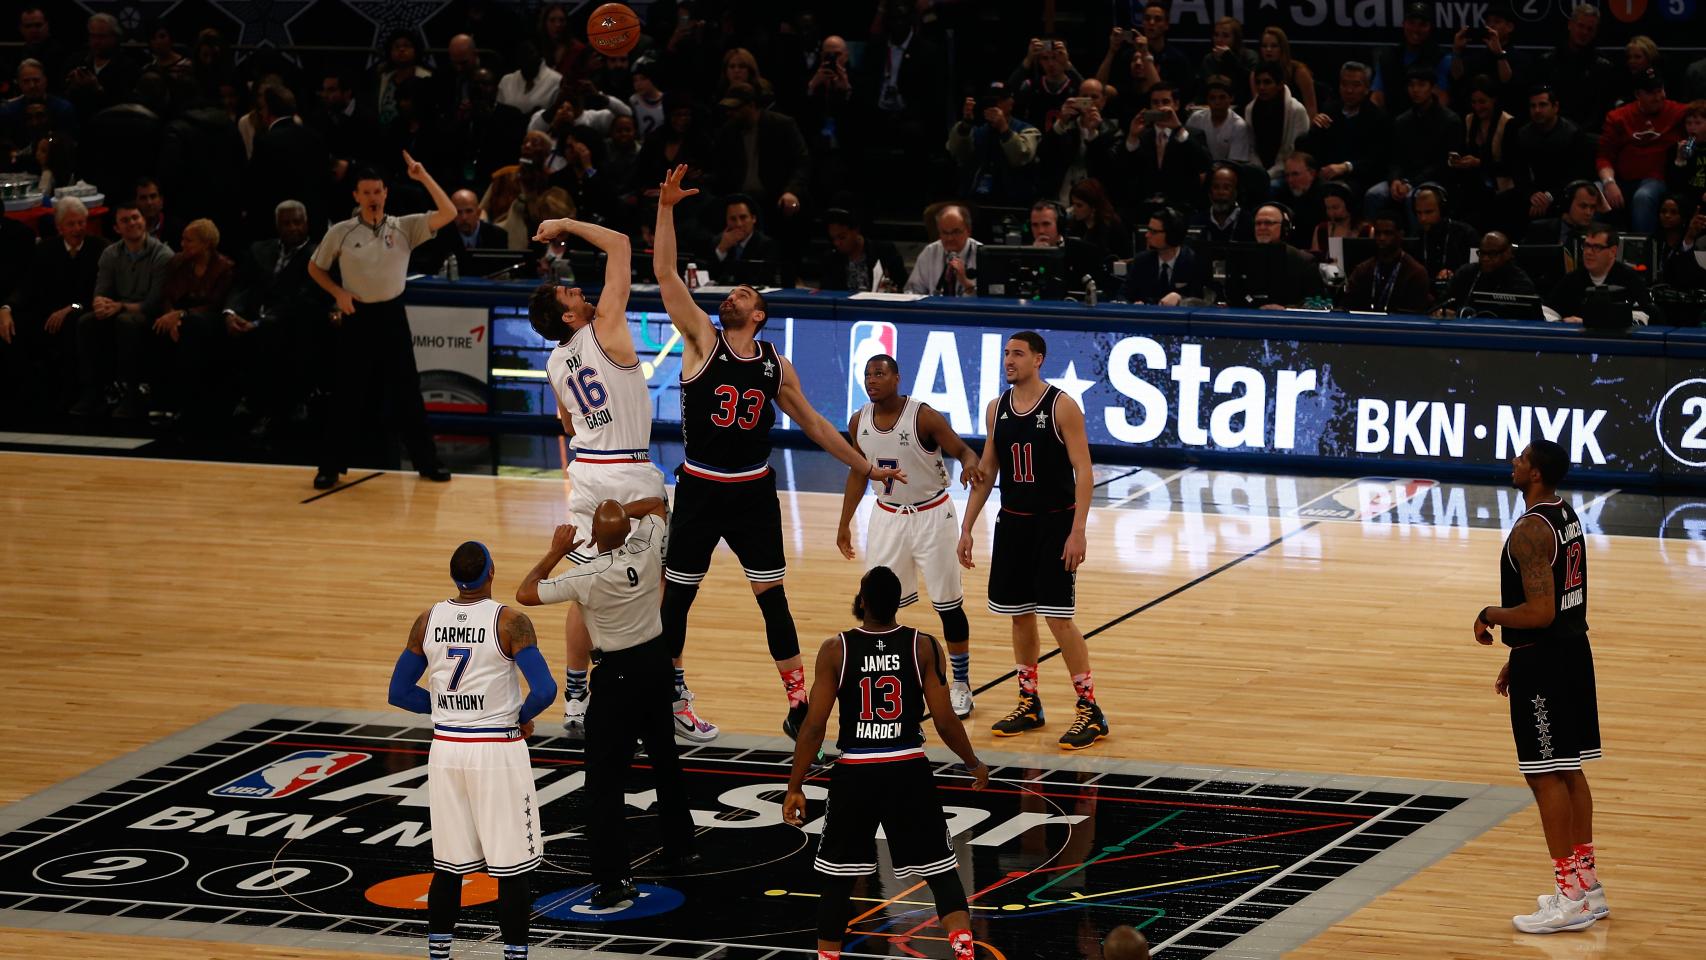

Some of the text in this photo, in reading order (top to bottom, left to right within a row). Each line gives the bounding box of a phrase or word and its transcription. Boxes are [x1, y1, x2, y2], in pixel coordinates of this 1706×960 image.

[1290, 0, 1404, 28] Sta
[411, 335, 473, 350] UMHO TIRE
[566, 365, 609, 416] 16
[1104, 335, 1317, 449] Star
[711, 384, 766, 430] 33
[1681, 396, 1706, 449] 2
[1011, 442, 1035, 483] 11
[1300, 508, 1350, 518] NBA
[626, 566, 639, 587] 9
[1564, 541, 1582, 591] 12
[435, 627, 486, 644] CARMELO
[446, 646, 473, 692] 7
[861, 654, 901, 673] JAMES
[437, 693, 486, 711] ANTHONY
[859, 675, 903, 721] 13
[856, 721, 903, 740] HARDEN
[220, 786, 270, 796] NBA
[62, 855, 149, 881] 2
